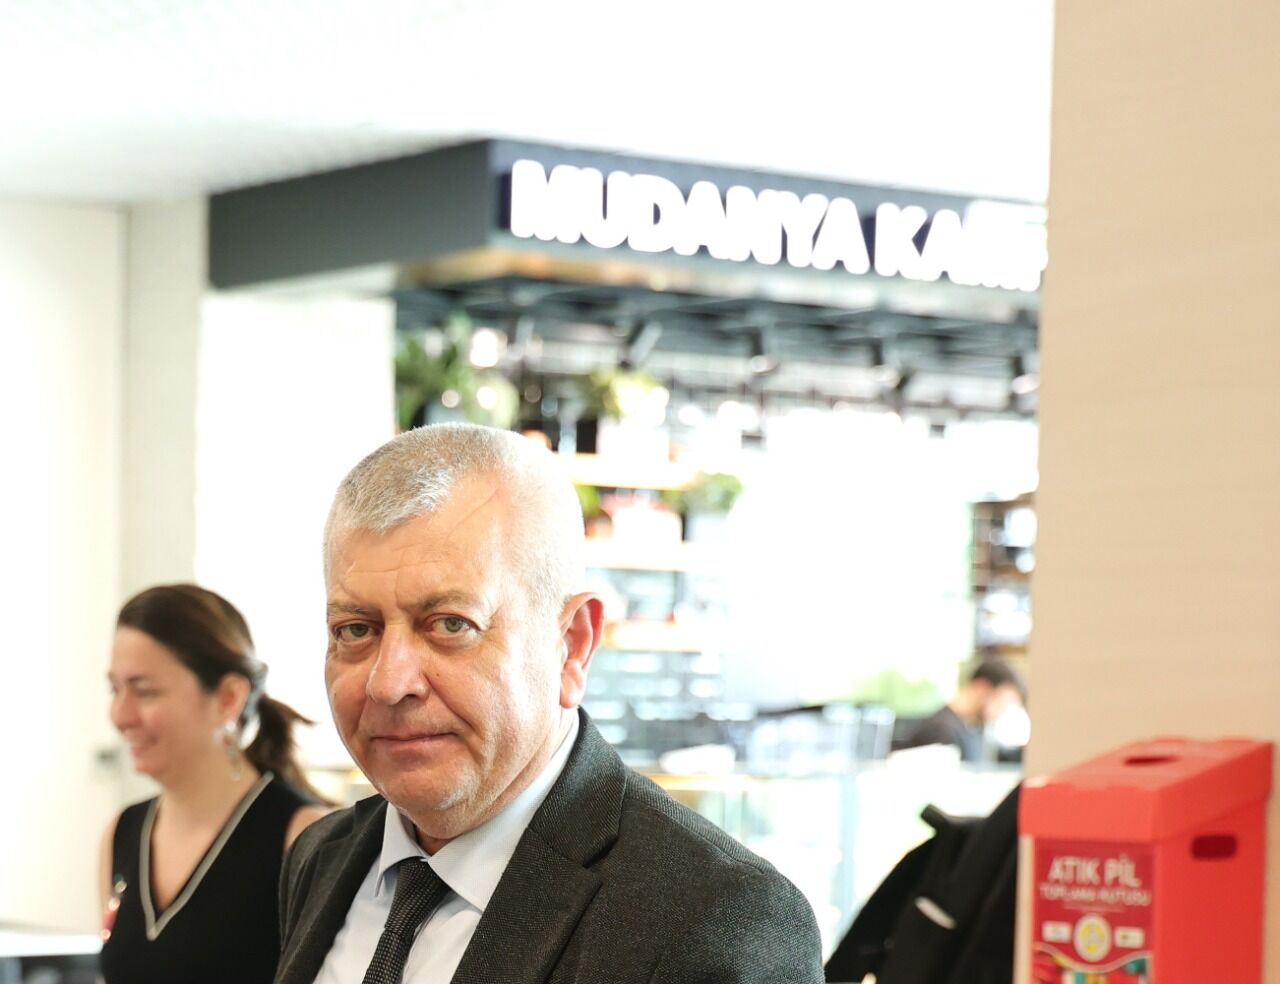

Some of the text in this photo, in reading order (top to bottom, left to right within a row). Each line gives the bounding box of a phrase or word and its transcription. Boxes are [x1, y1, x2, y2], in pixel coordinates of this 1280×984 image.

[509, 158, 872, 277] MUDANYA
[1048, 853, 1142, 888] ATIK PİL
